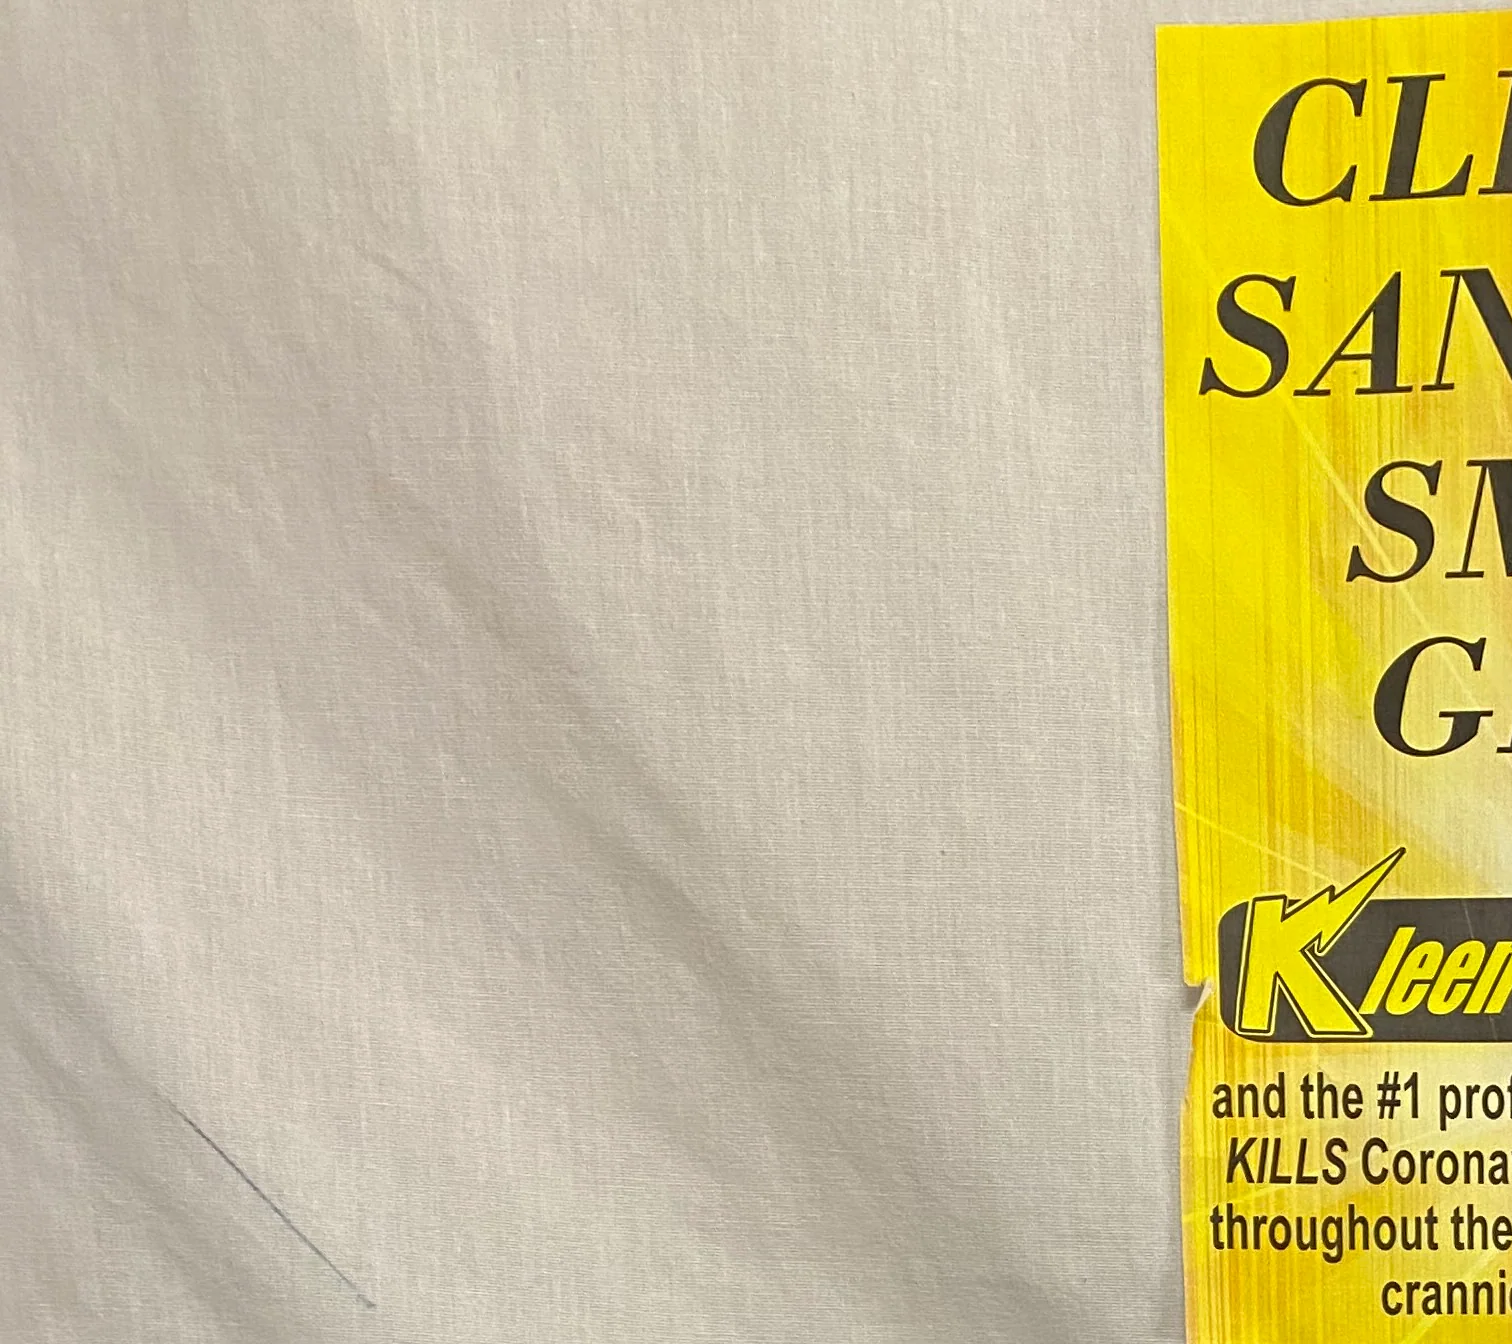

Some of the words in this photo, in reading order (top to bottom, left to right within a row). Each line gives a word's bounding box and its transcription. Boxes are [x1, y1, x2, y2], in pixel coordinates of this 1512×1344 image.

[1212, 1071, 1286, 1119] and
[1300, 1071, 1364, 1120] the
[1376, 1071, 1419, 1120] #1
[1226, 1137, 1349, 1186] KILLS
[1209, 1202, 1439, 1264] throughout
